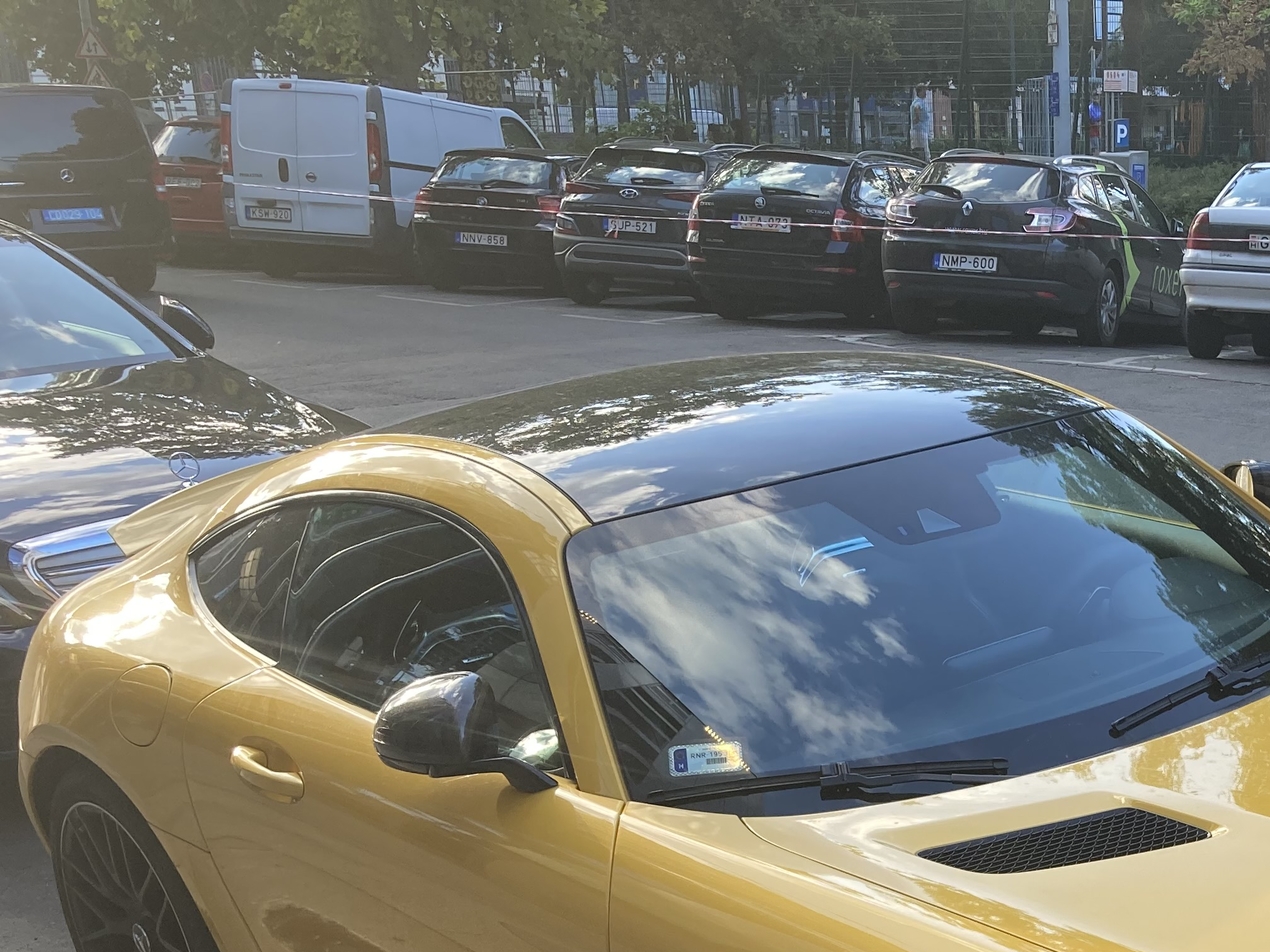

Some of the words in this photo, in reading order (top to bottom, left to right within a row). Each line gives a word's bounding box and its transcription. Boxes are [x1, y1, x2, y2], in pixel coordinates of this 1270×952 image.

[1116, 124, 1128, 144] P
[251, 208, 290, 220] KSW-920
[461, 232, 505, 245] NNV-858
[941, 255, 995, 270] NMP-600
